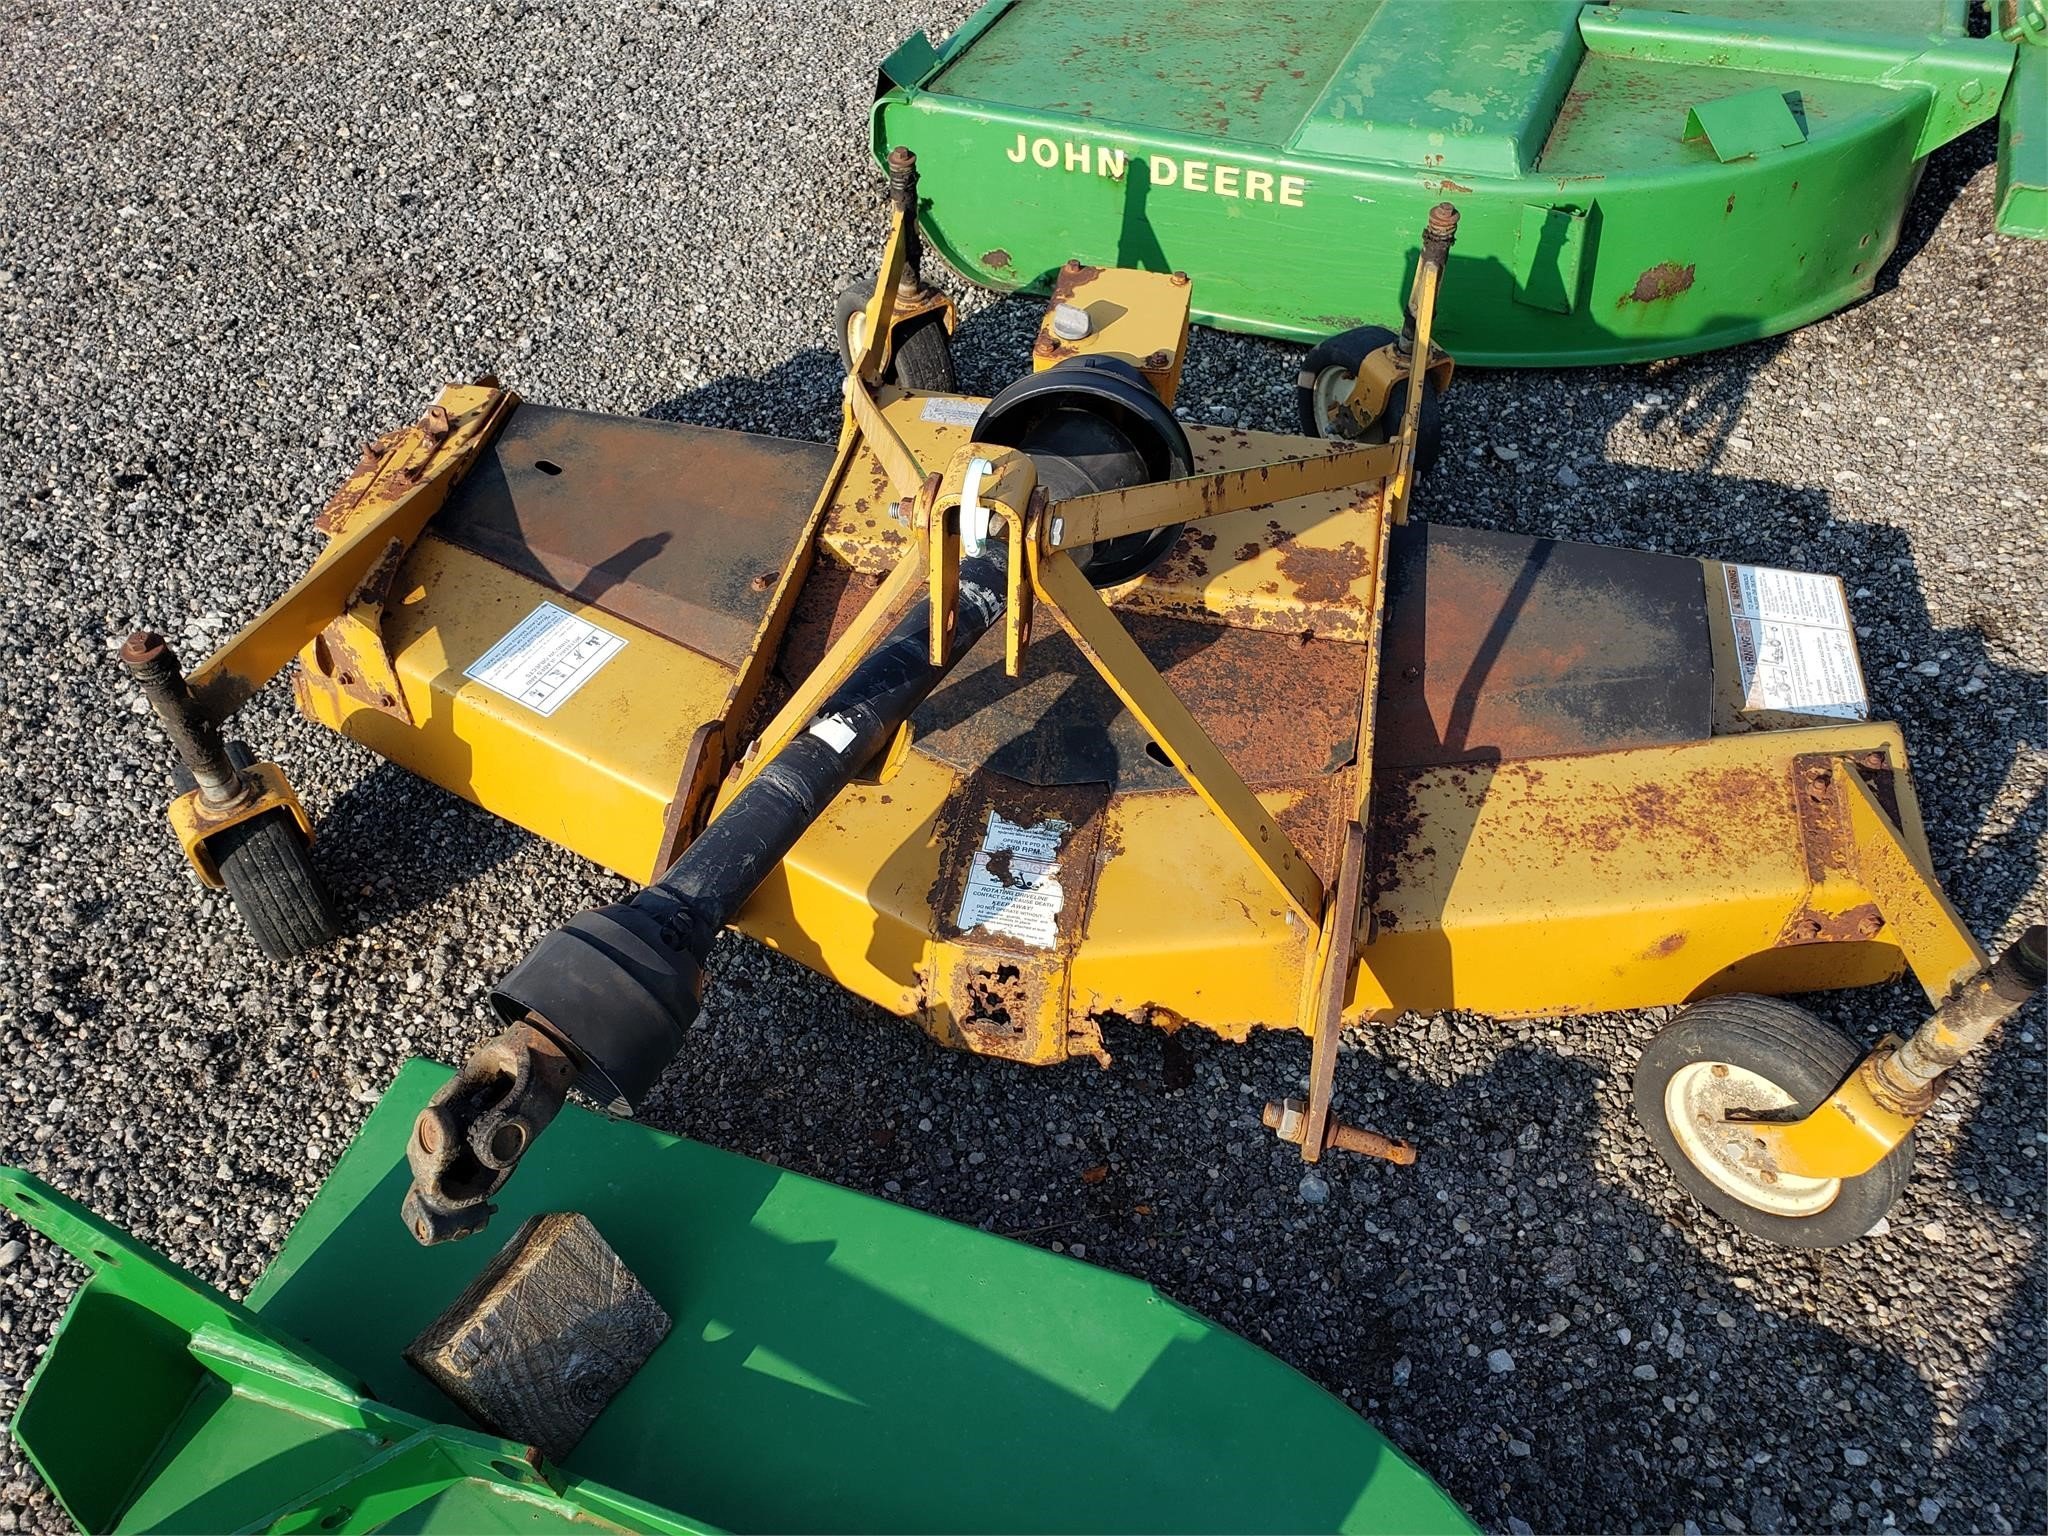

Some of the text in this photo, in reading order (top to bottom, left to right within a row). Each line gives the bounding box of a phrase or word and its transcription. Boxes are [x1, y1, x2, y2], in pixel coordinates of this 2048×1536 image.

[1007, 134, 1305, 208] JOHN DEERE
[1003, 838, 1028, 846] OPERATE
[973, 891, 999, 899] CONTACT
[981, 887, 1048, 901] ROTATING DRIVELINE
